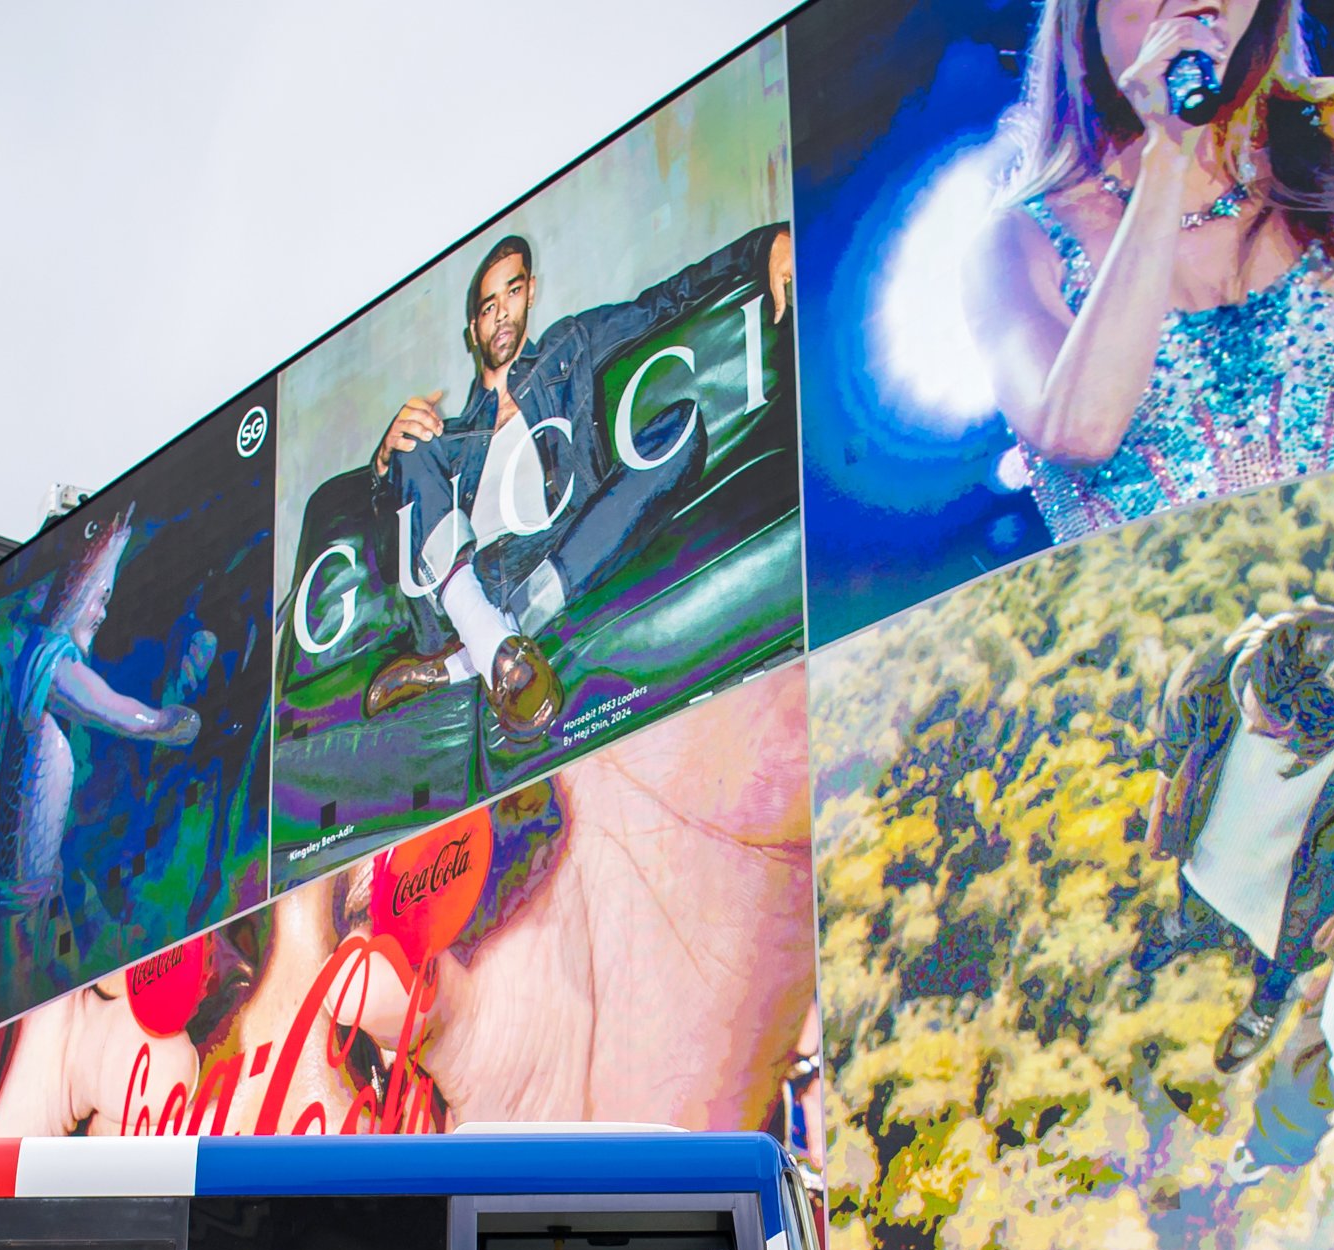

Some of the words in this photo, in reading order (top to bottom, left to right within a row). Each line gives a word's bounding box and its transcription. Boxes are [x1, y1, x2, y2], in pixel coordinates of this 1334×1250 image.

[293, 293, 768, 654] GUCCI
[563, 707, 597, 732] Horsebit
[598, 698, 617, 715] 1953
[617, 685, 648, 706] Loafers
[563, 735, 573, 747] By
[610, 706, 632, 724] 2024
[289, 840, 321, 862] Kingsley
